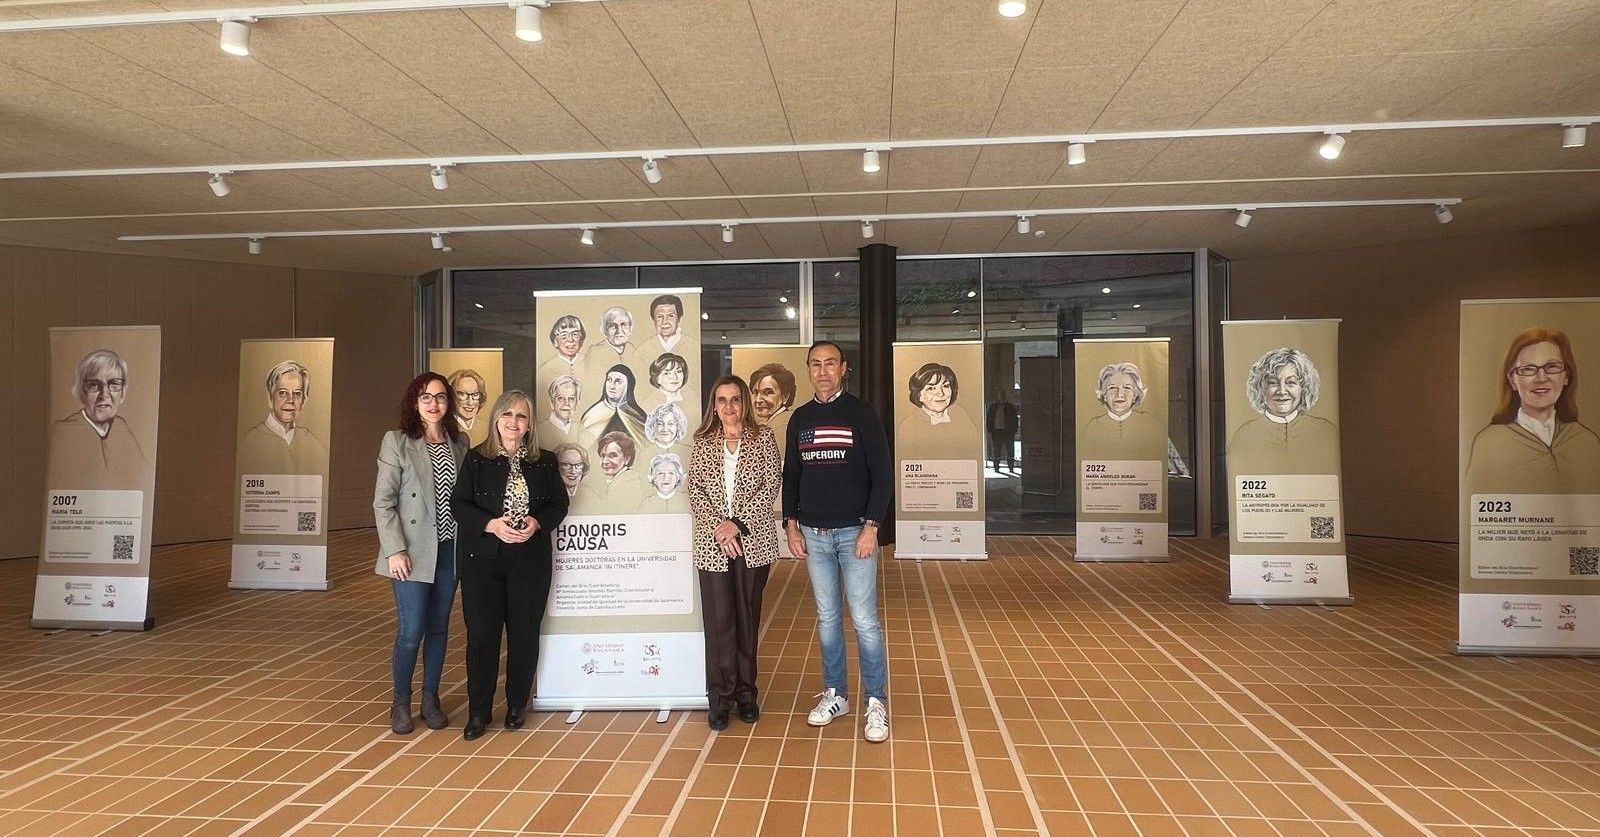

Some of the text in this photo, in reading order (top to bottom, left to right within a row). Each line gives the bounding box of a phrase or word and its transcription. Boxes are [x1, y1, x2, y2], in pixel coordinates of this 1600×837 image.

[802, 450, 846, 460] SUPERDRY
[1242, 481, 1267, 489] 2022
[52, 496, 77, 506] 2007
[1479, 501, 1511, 512] 2023
[556, 523, 627, 537] HONORIS
[556, 537, 608, 550] CAUSA
